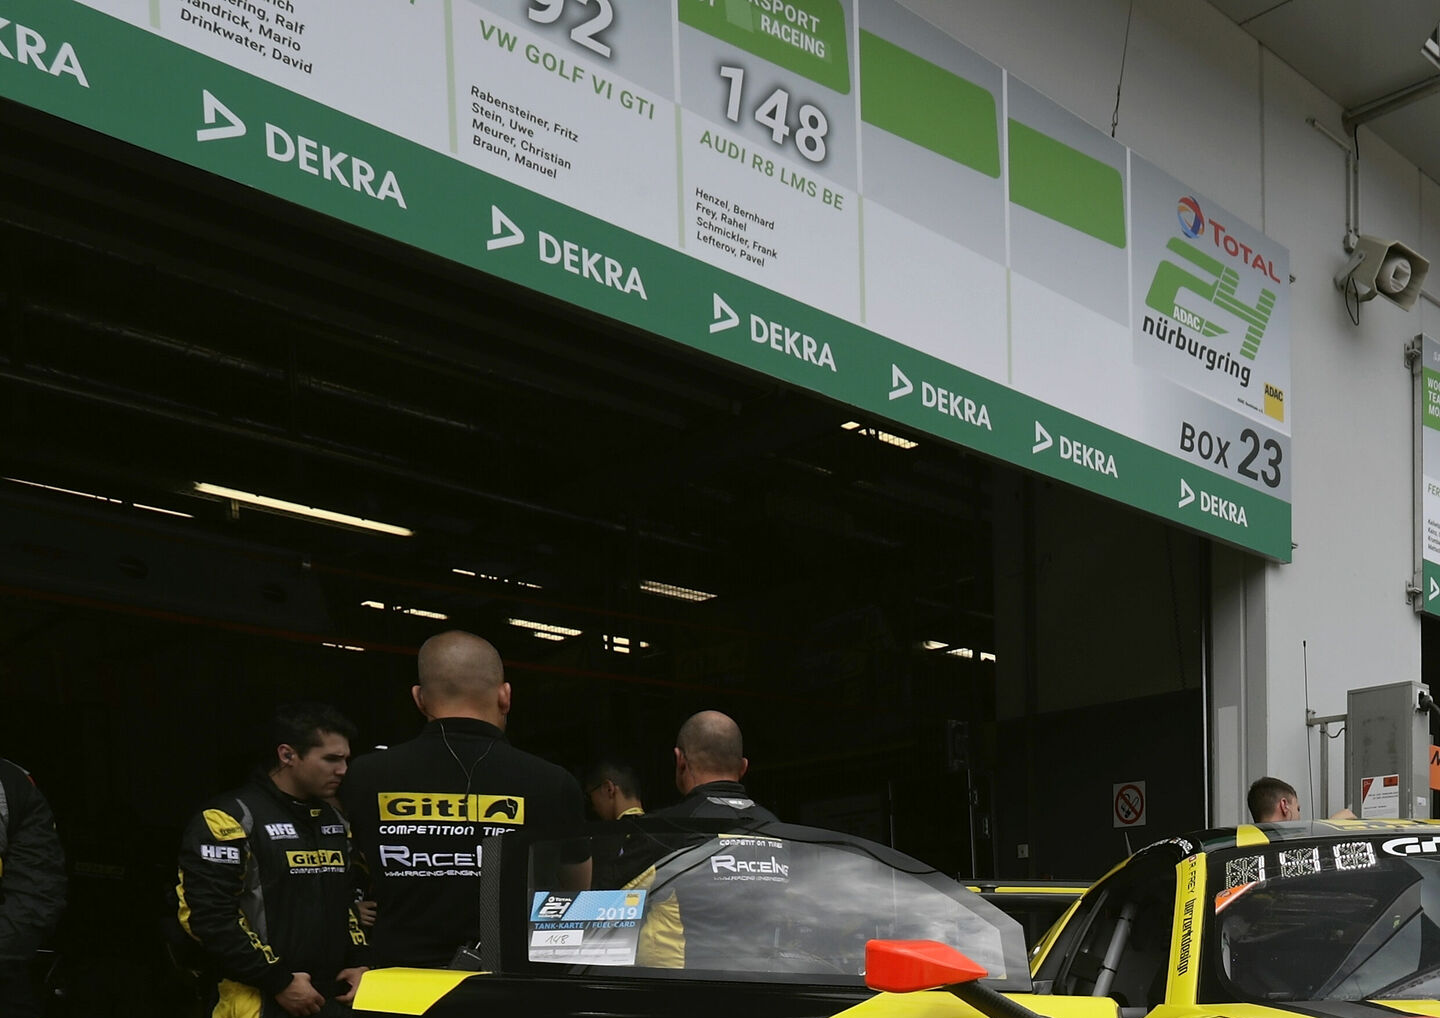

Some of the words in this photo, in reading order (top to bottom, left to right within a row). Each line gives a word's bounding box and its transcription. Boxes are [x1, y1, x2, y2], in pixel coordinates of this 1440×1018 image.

[180, 8, 266, 56] Drinkwater,
[272, 48, 313, 74] David
[259, 24, 301, 51] Mario
[275, 14, 305, 35] Ralf
[760, 13, 825, 58] RACEING
[480, 19, 517, 52] VW
[525, 44, 585, 83] GOLF
[592, 74, 613, 100] VI
[620, 90, 655, 120] GTI
[471, 85, 549, 131] Rabensteiner,
[553, 123, 579, 142] Fritz
[471, 102, 505, 127] Stein,
[509, 118, 534, 137] Uwe
[720, 65, 828, 162] 148
[472, 118, 516, 148] Meurer,
[520, 140, 572, 170] Christian
[472, 134, 510, 161] Braun,
[514, 152, 557, 179] Manuel
[265, 122, 407, 210] DEKRA
[700, 130, 746, 164] AUDI
[752, 153, 774, 177] R8
[780, 167, 817, 197] LMS
[822, 187, 844, 211] BE
[695, 187, 731, 212] Henzel,
[733, 204, 775, 230] Bernhard
[696, 202, 718, 221] Frey,
[720, 213, 747, 232] Rahel
[696, 217, 750, 248] Schmickler,
[752, 241, 778, 259] Frank
[696, 231, 737, 257] Lefterov,
[740, 250, 765, 268] Pavel
[1208, 218, 1281, 284] TOTAL
[539, 230, 648, 301] DEKRA
[1172, 305, 1201, 331] ADAC
[750, 313, 837, 372] DEKRA
[1142, 314, 1251, 388] nürburgring
[922, 381, 992, 431] DEKRA
[1264, 384, 1284, 402] ADAC
[1059, 435, 1118, 479] DEKRA
[1179, 421, 1231, 469] BOX
[1237, 428, 1283, 489] 23
[1200, 490, 1248, 528] DEKRA
[387, 798, 469, 817] Giti
[264, 823, 298, 836] HFG
[379, 825, 475, 836] COMPETITION
[201, 845, 240, 860] HFG
[1187, 871, 1197, 894] FREY
[534, 922, 583, 930] TANK-KARTE
[592, 921, 636, 929] FUEL-CARD
[597, 906, 638, 921] 2019
[545, 934, 569, 945] 148
